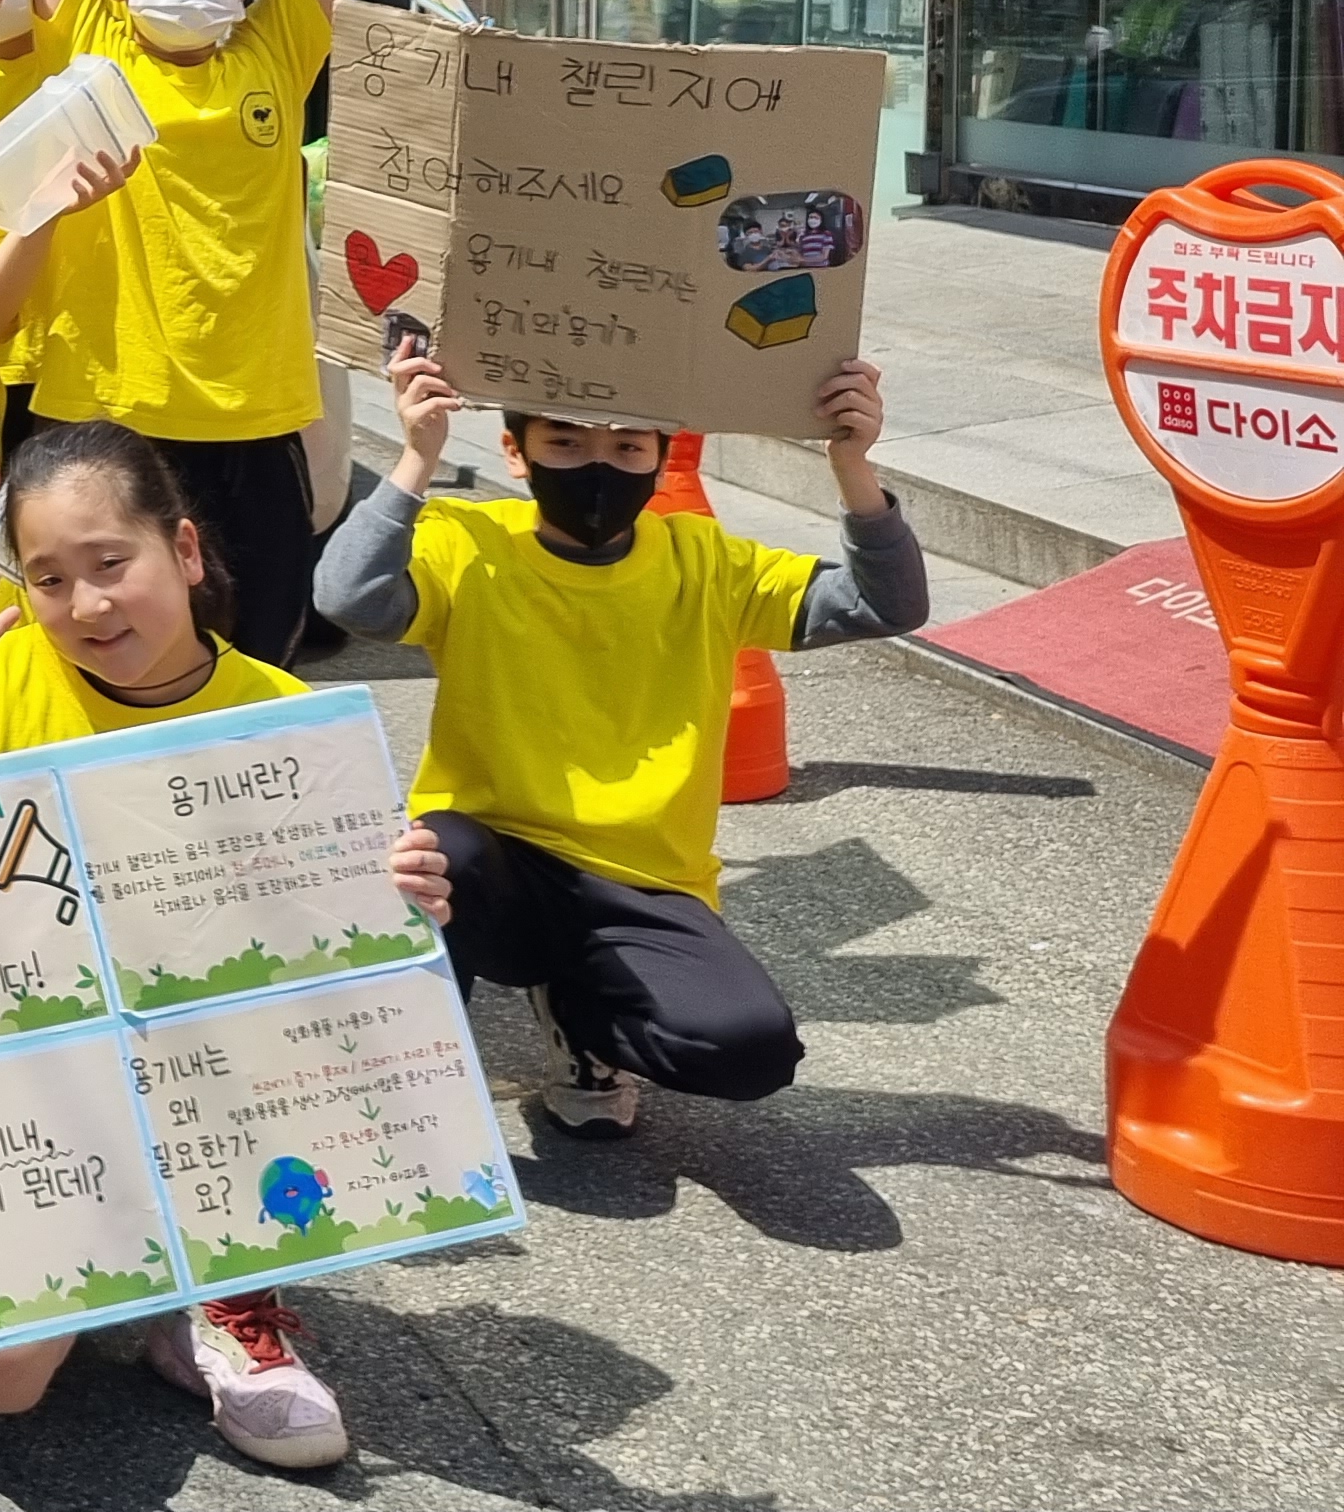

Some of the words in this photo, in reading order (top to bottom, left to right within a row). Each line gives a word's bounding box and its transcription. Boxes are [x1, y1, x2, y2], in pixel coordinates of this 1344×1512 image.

[560, 57, 783, 112] 챌린지에
[373, 127, 625, 205] 참여해주세요
[1173, 241, 1203, 257] 협조
[1210, 245, 1240, 261] 부탁
[1246, 248, 1316, 270] 드립니다
[1163, 414, 1194, 431] daiso
[1206, 398, 1339, 453] 다이소
[167, 756, 301, 818] 용기내란?
[184, 841, 211, 862] 음식
[217, 830, 268, 855] 포장으로
[272, 819, 326, 844] 발생하는
[331, 807, 384, 834] 불필요한
[112, 876, 167, 902] 줄이자는
[173, 866, 226, 892] 취지에서
[151, 895, 207, 917] 식재료나
[213, 880, 250, 907] 음식을
[282, 1018, 333, 1041] 일회용품
[336, 1011, 374, 1030] 사용의
[376, 1005, 404, 1026] 증가
[129, 1043, 232, 1096] 용기내는
[169, 1095, 201, 1127] 왜
[151, 1128, 258, 1180] 필요한가
[338, 1128, 379, 1148] 온난화
[22, 1153, 106, 1210] 뭔데?
[195, 1175, 234, 1216] 요?
[347, 1174, 386, 1192] 지구가
